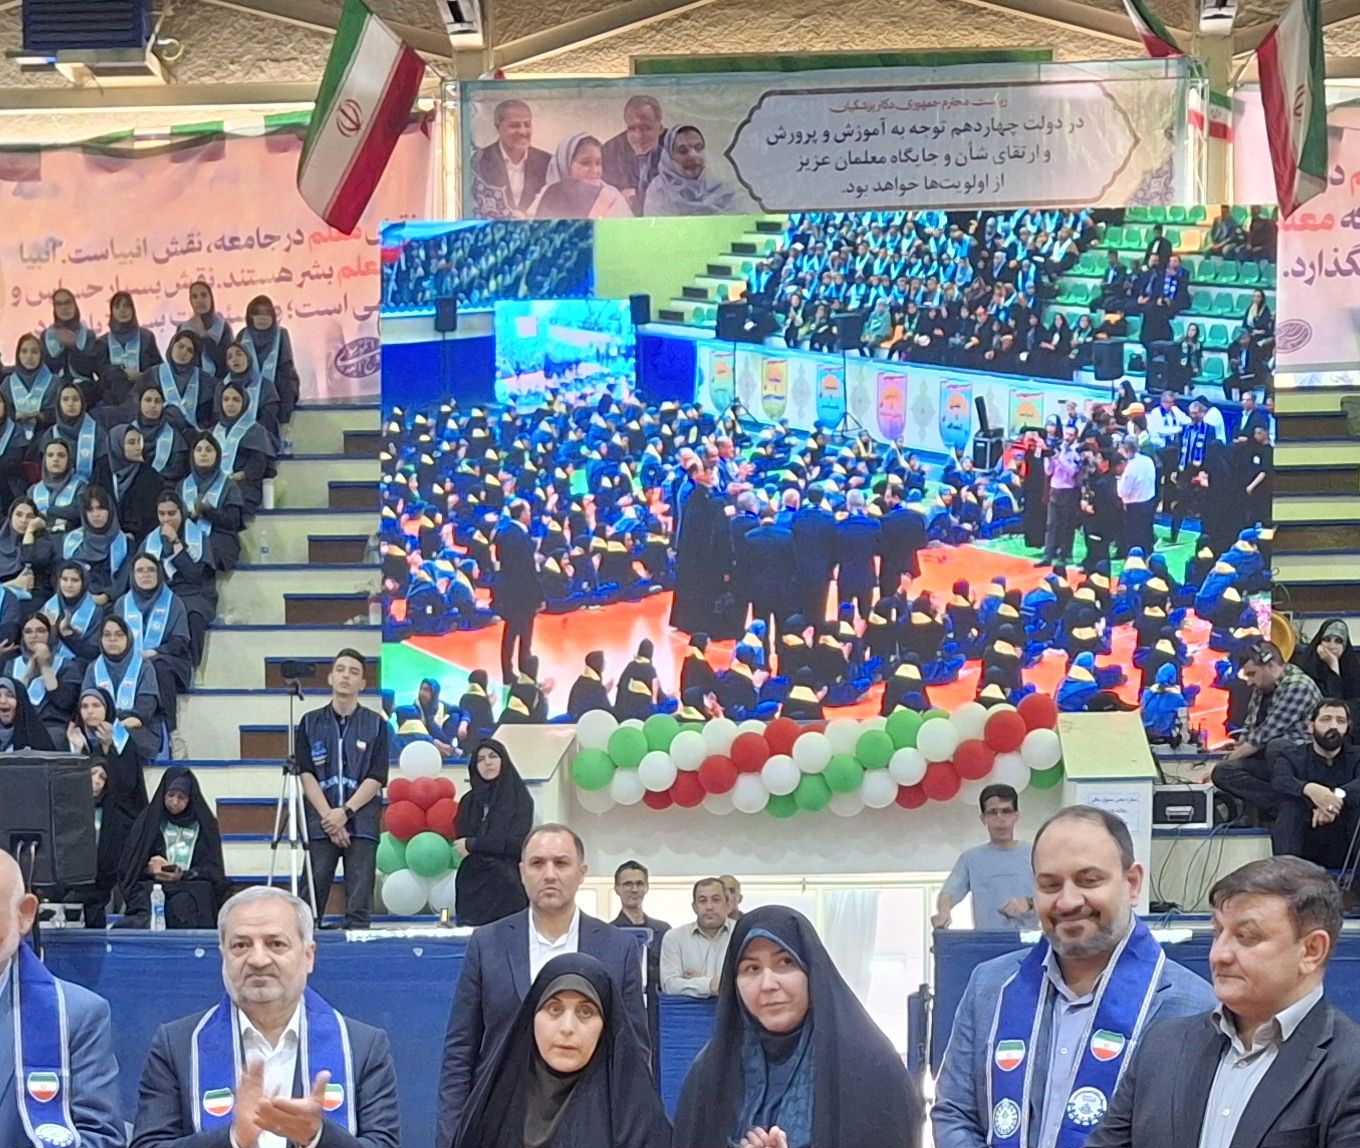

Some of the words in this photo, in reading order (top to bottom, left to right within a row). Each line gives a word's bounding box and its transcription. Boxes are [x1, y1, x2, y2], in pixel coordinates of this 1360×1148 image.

[766, 124, 817, 145] پرورش
[834, 117, 885, 143] آموزش
[891, 125, 905, 140] به
[909, 120, 946, 139] توجه
[951, 117, 1019, 138] چهاردهم
[1024, 116, 1063, 135] دولت
[1069, 117, 1084, 134] در
[823, 130, 830, 143] و
[796, 154, 830, 172] عزیز
[834, 149, 886, 171] معلمان
[890, 147, 938, 167] جایگاه
[944, 154, 951, 166] و
[955, 141, 988, 166] شأن
[993, 144, 1039, 165] ارتقای
[1043, 149, 1051, 163] و
[841, 181, 869, 198] بود.
[873, 176, 918, 197] خواهد
[992, 173, 1005, 192] از
[153, 233, 202, 264] نقش
[207, 228, 281, 252] جامعه،
[284, 228, 304, 252] در
[297, 261, 334, 288] بشر
[338, 255, 379, 285] علم
[11, 286, 22, 307] و
